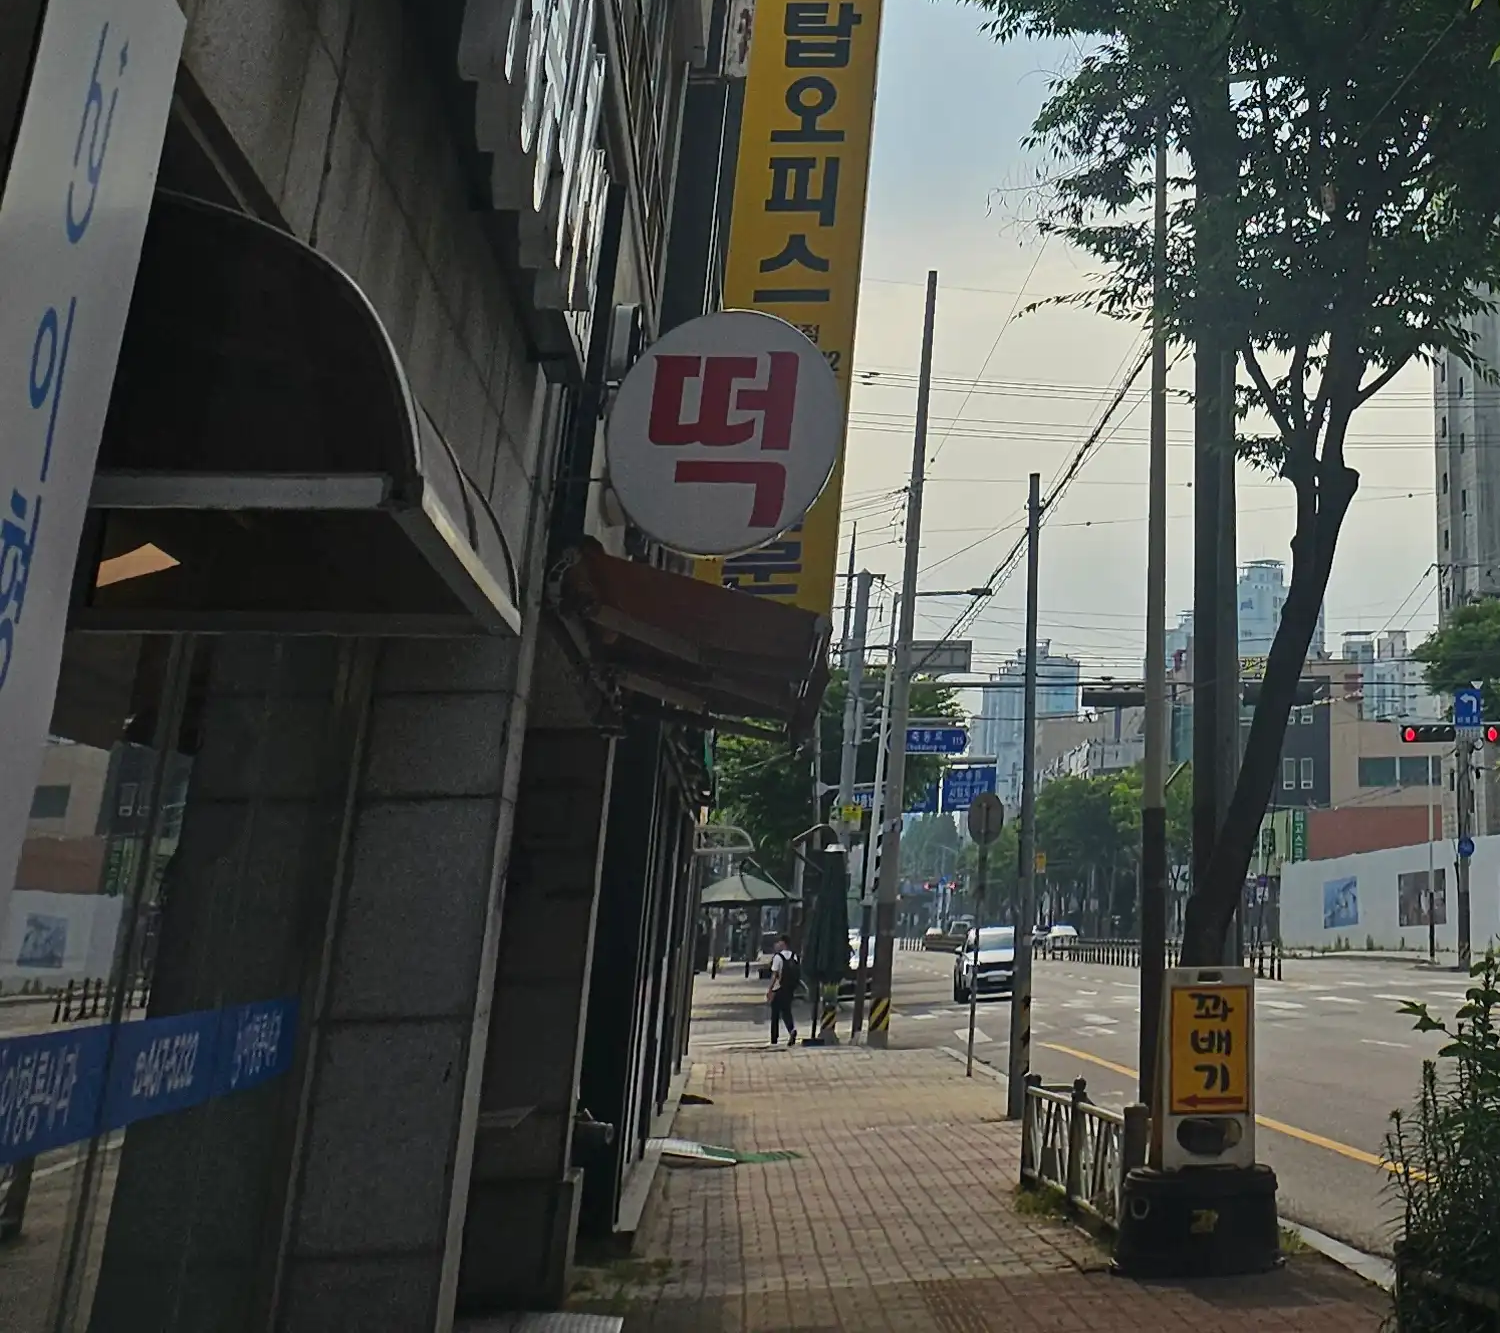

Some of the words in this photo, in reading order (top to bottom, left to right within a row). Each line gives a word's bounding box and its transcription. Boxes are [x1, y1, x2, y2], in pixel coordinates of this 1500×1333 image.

[752, 1, 862, 304] 탑오피스
[648, 350, 800, 529] 떡
[1188, 992, 1234, 1094] 꽈배기
